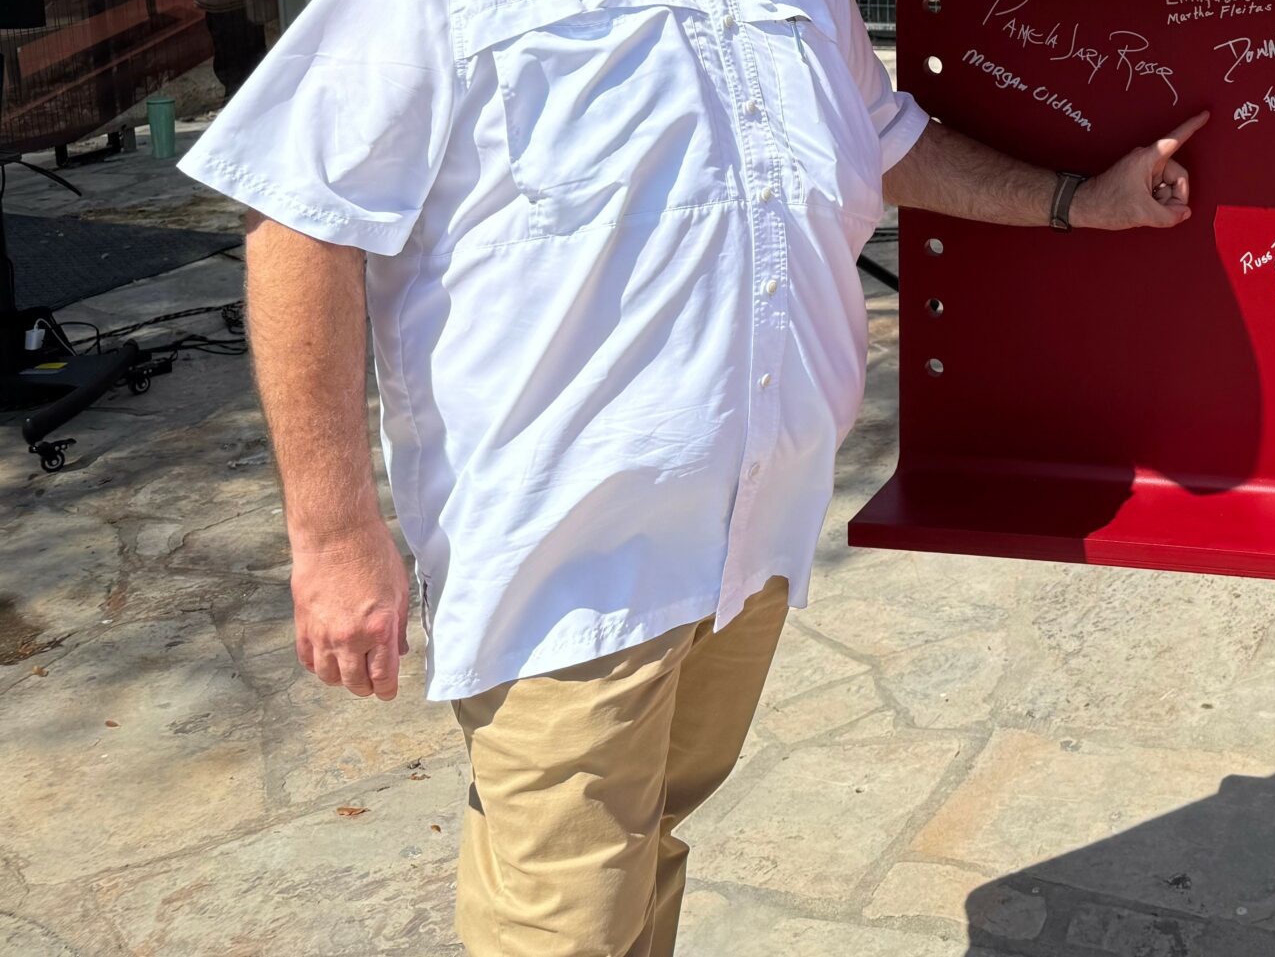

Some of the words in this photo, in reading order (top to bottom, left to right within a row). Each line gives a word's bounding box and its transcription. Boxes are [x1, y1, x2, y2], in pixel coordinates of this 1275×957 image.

[1167, 6, 1214, 25] Martha
[1220, 1, 1272, 19] Fleitas
[1239, 251, 1273, 275] Russ
